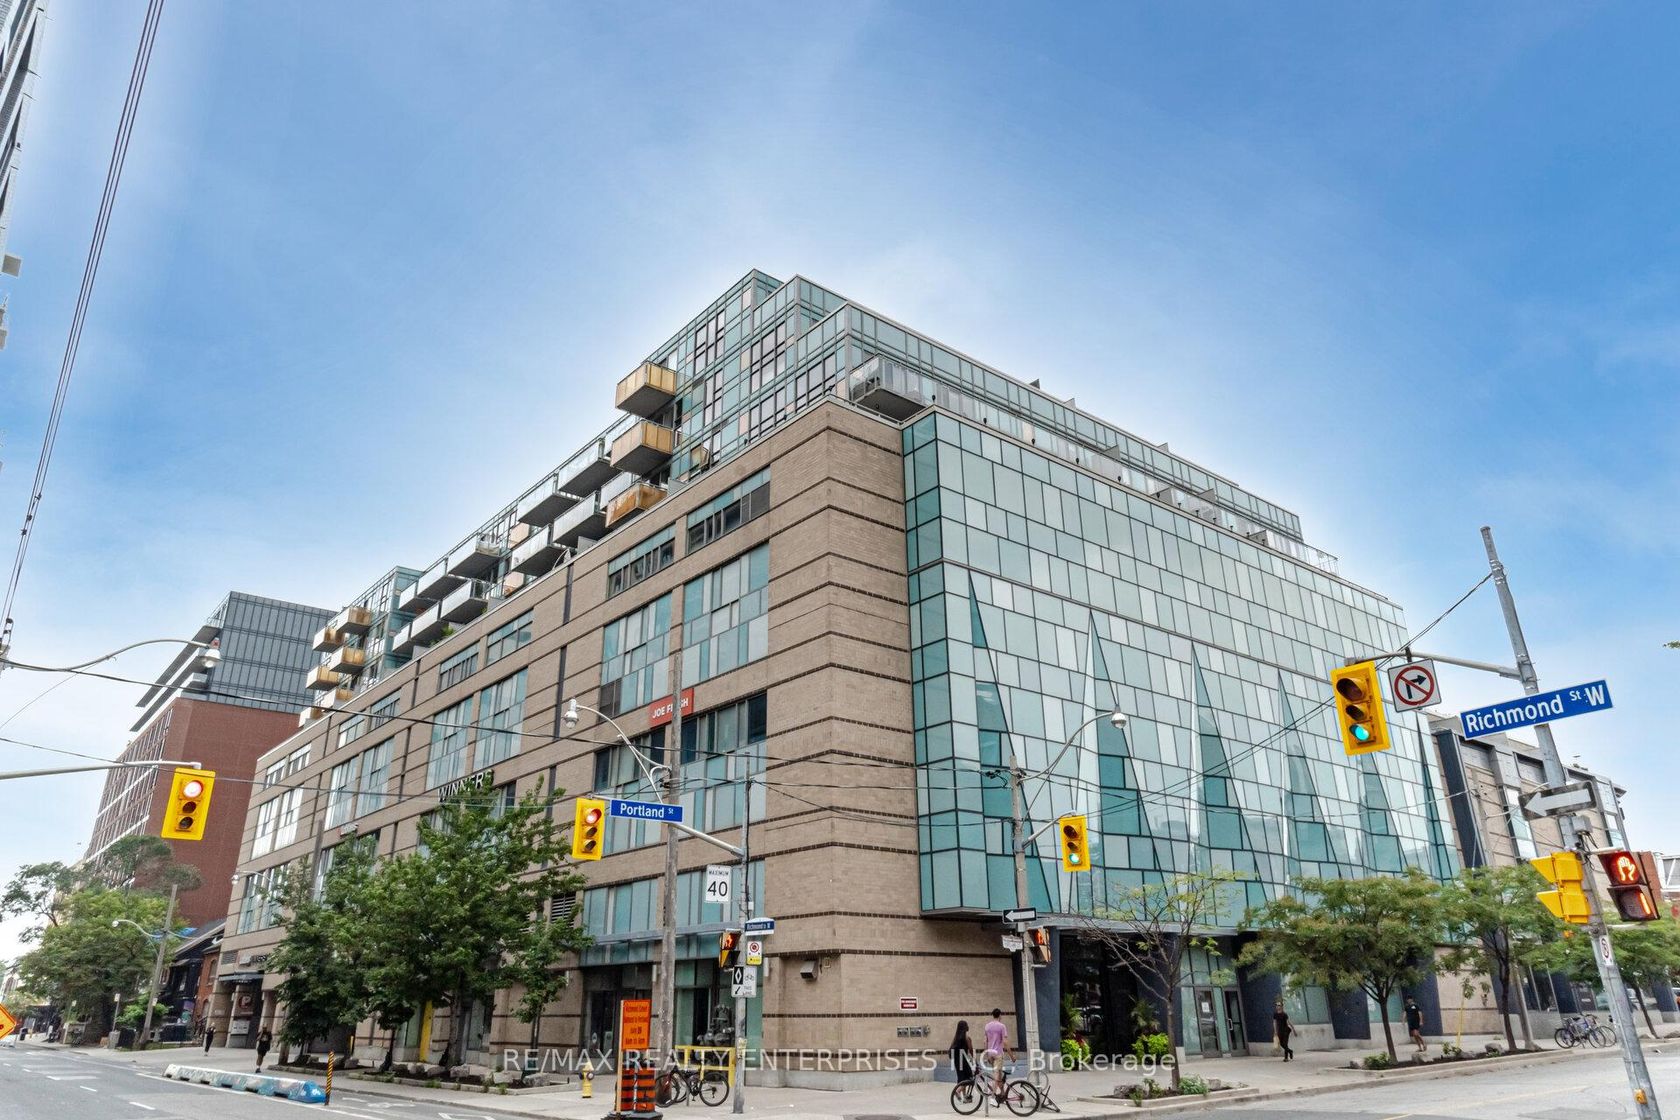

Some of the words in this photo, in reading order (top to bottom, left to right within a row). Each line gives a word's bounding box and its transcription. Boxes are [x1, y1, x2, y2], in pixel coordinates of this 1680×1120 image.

[652, 706, 666, 719] JOE
[1465, 694, 1564, 733] Richmond
[1569, 690, 1582, 702] St
[1585, 684, 1605, 707] W
[620, 803, 665, 819] Portland
[667, 807, 674, 815] St
[707, 880, 728, 897] 40
